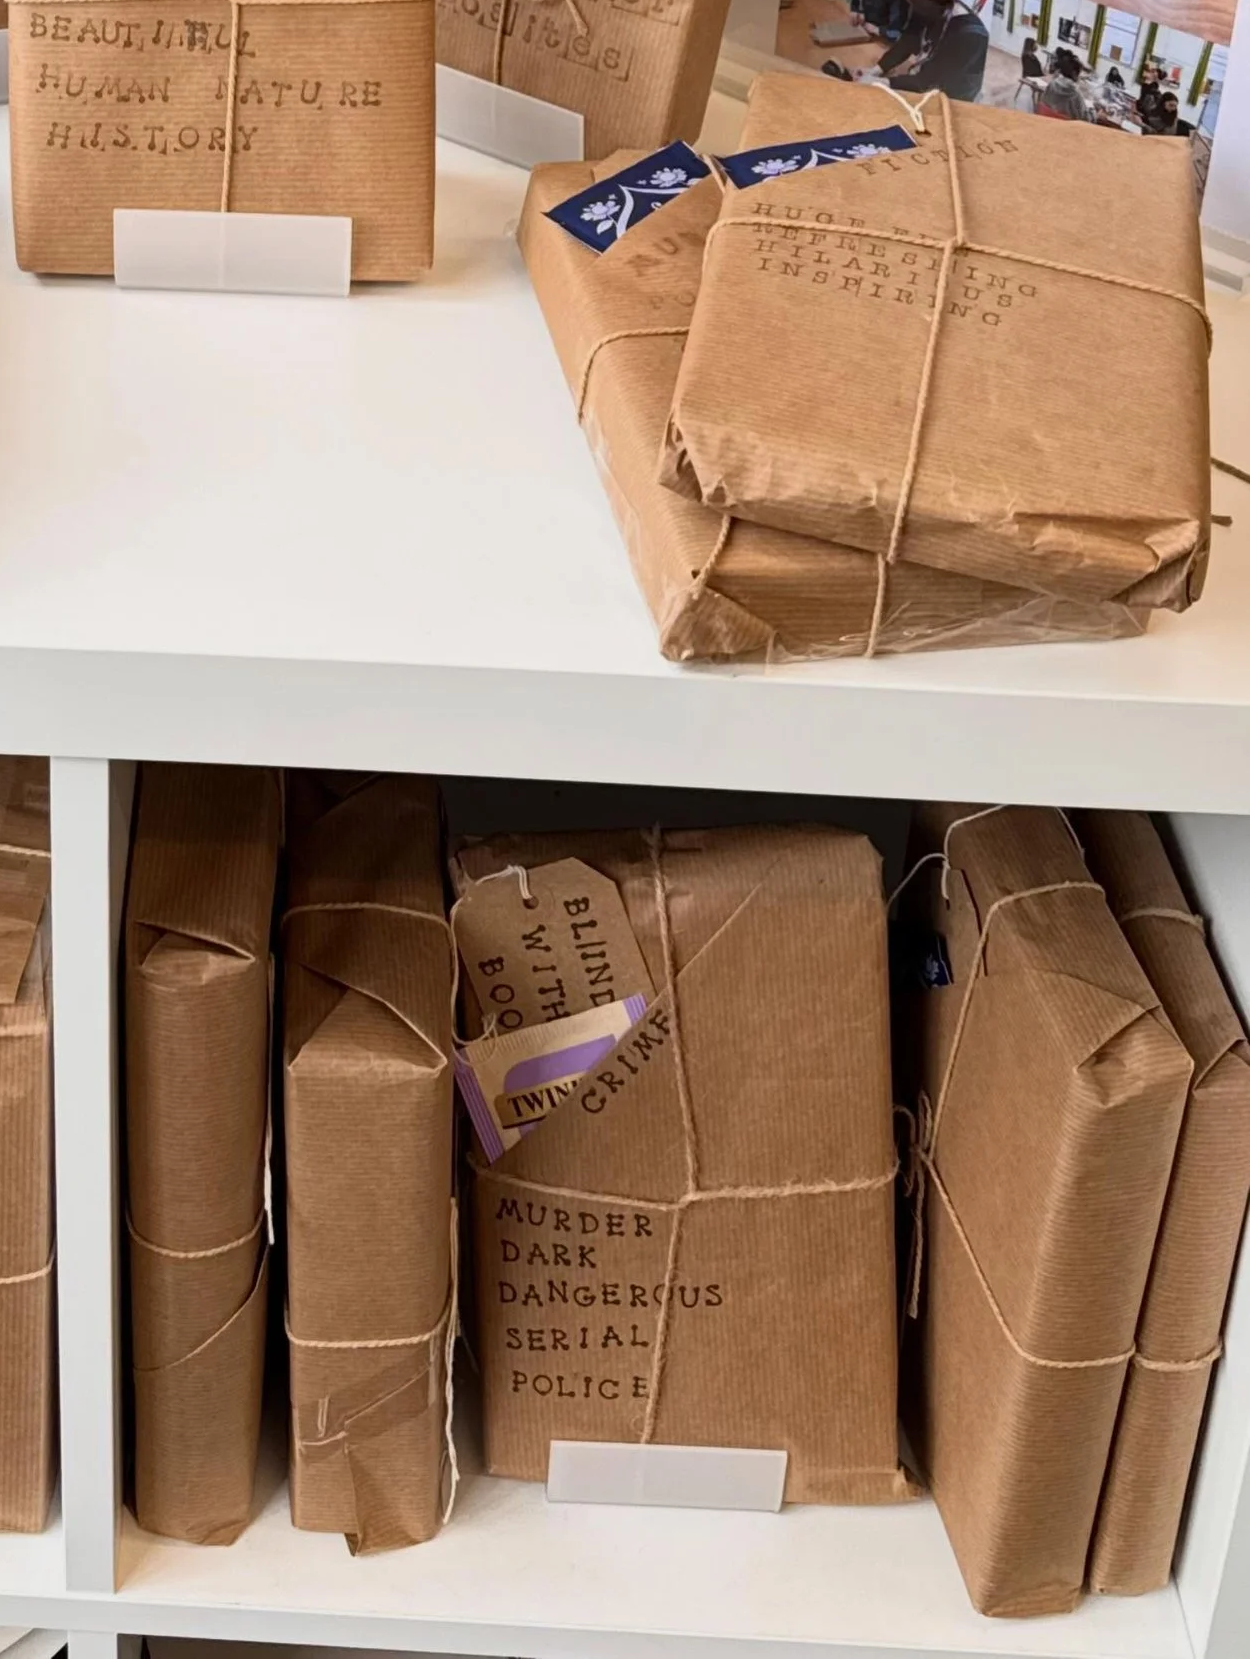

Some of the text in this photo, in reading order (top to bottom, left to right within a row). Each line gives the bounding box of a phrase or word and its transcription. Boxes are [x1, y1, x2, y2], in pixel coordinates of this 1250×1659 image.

[35, 62, 383, 110] HUMAN NATURE
[46, 121, 260, 156] HISTORY
[857, 139, 1020, 177] FICTION
[477, 957, 524, 1030] BOO
[496, 1198, 654, 1238] MURDER
[501, 1240, 598, 1269] DARK
[498, 1280, 724, 1309] DANGEROUS
[506, 1324, 650, 1351] SERIAL
[511, 1372, 649, 1400] POLICE
